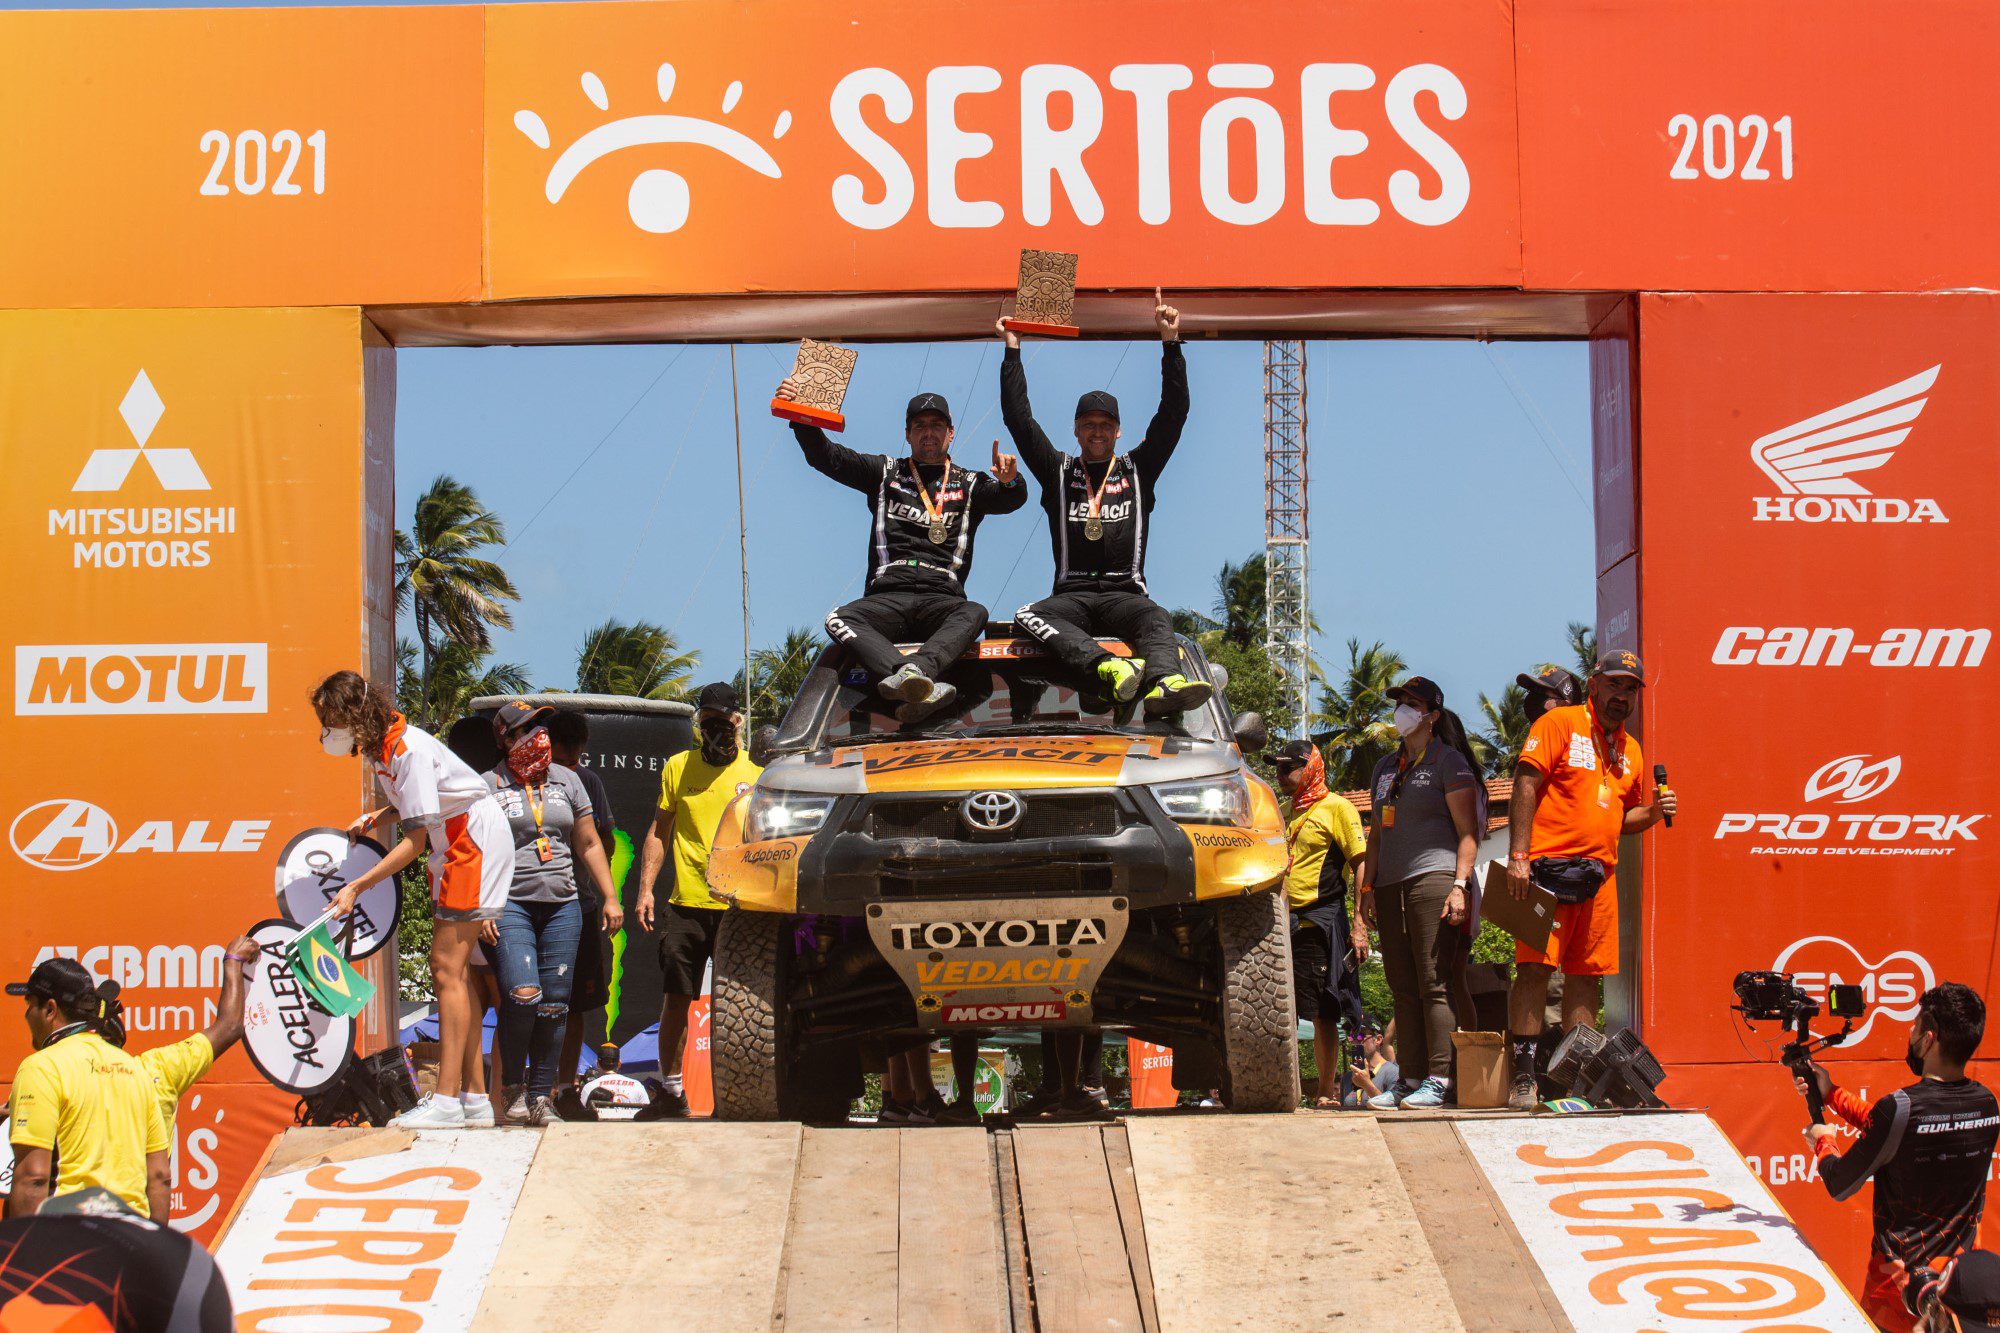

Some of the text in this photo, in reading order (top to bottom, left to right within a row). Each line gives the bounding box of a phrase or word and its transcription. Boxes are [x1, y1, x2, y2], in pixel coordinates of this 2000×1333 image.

[1667, 113, 1793, 180] 2021
[199, 129, 326, 196] 2021
[48, 507, 236, 535] MITSUBISHI
[887, 499, 960, 526] VEDAIT
[1068, 500, 1132, 520] VEACIT
[1752, 496, 1949, 523] HONDA
[73, 540, 211, 568] MOTORS
[1711, 626, 1992, 667] can-am
[27, 655, 256, 704] MOTUL
[866, 747, 1125, 771] VEDACIT
[116, 820, 272, 852] ALE
[1193, 832, 1252, 848] Rodobens
[1713, 813, 1986, 841] PRO TORK
[1750, 846, 1956, 857] RACING DEVELOPMENT
[304, 849, 378, 943] OXETE!
[890, 918, 1107, 950] TOYOTA
[916, 957, 1090, 985] VEDACIT
[259, 939, 325, 1070] ACELERA
[947, 1004, 1061, 1022] MOTUL
[1515, 1139, 1832, 1333] SIGA@
